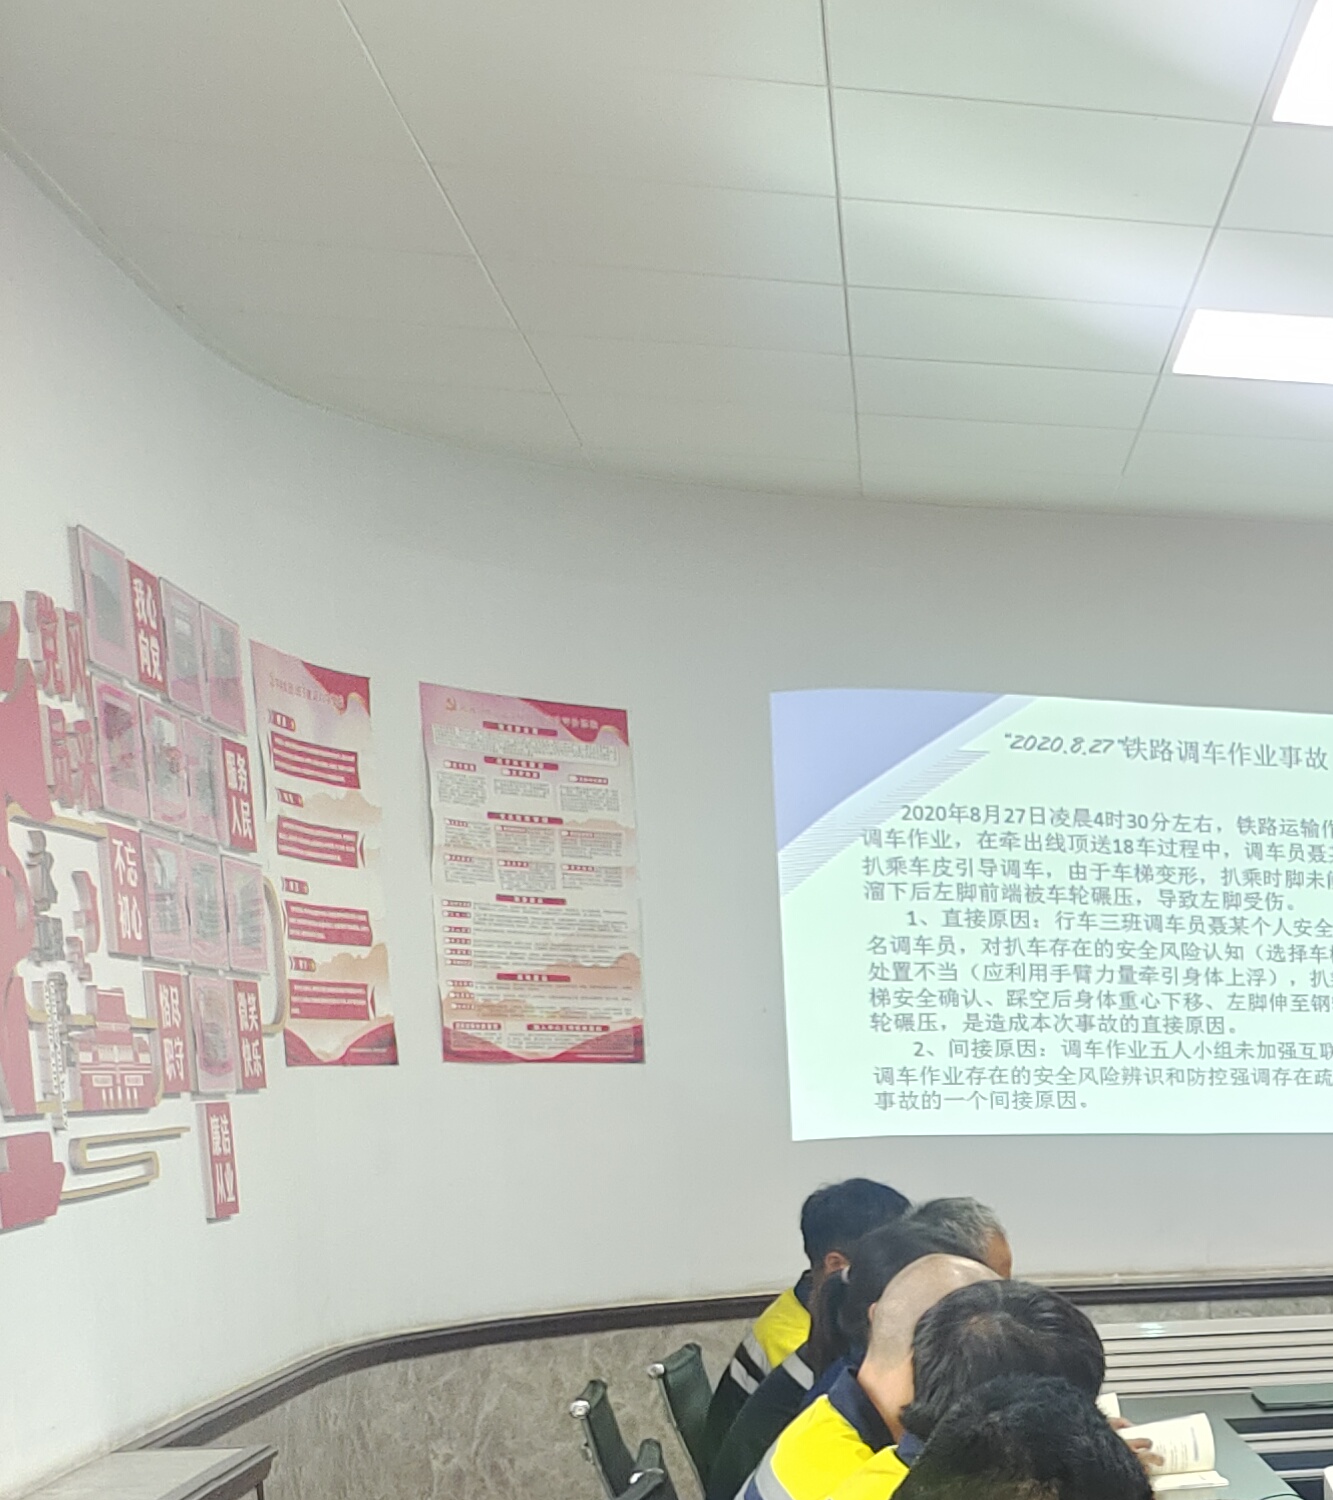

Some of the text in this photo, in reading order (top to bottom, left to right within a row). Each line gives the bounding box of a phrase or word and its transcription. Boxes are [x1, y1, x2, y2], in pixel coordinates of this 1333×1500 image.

[231, 797, 253, 840] 人民
[112, 838, 138, 887] 不忘
[118, 892, 143, 941] 初心
[215, 1162, 236, 1205] 从业
